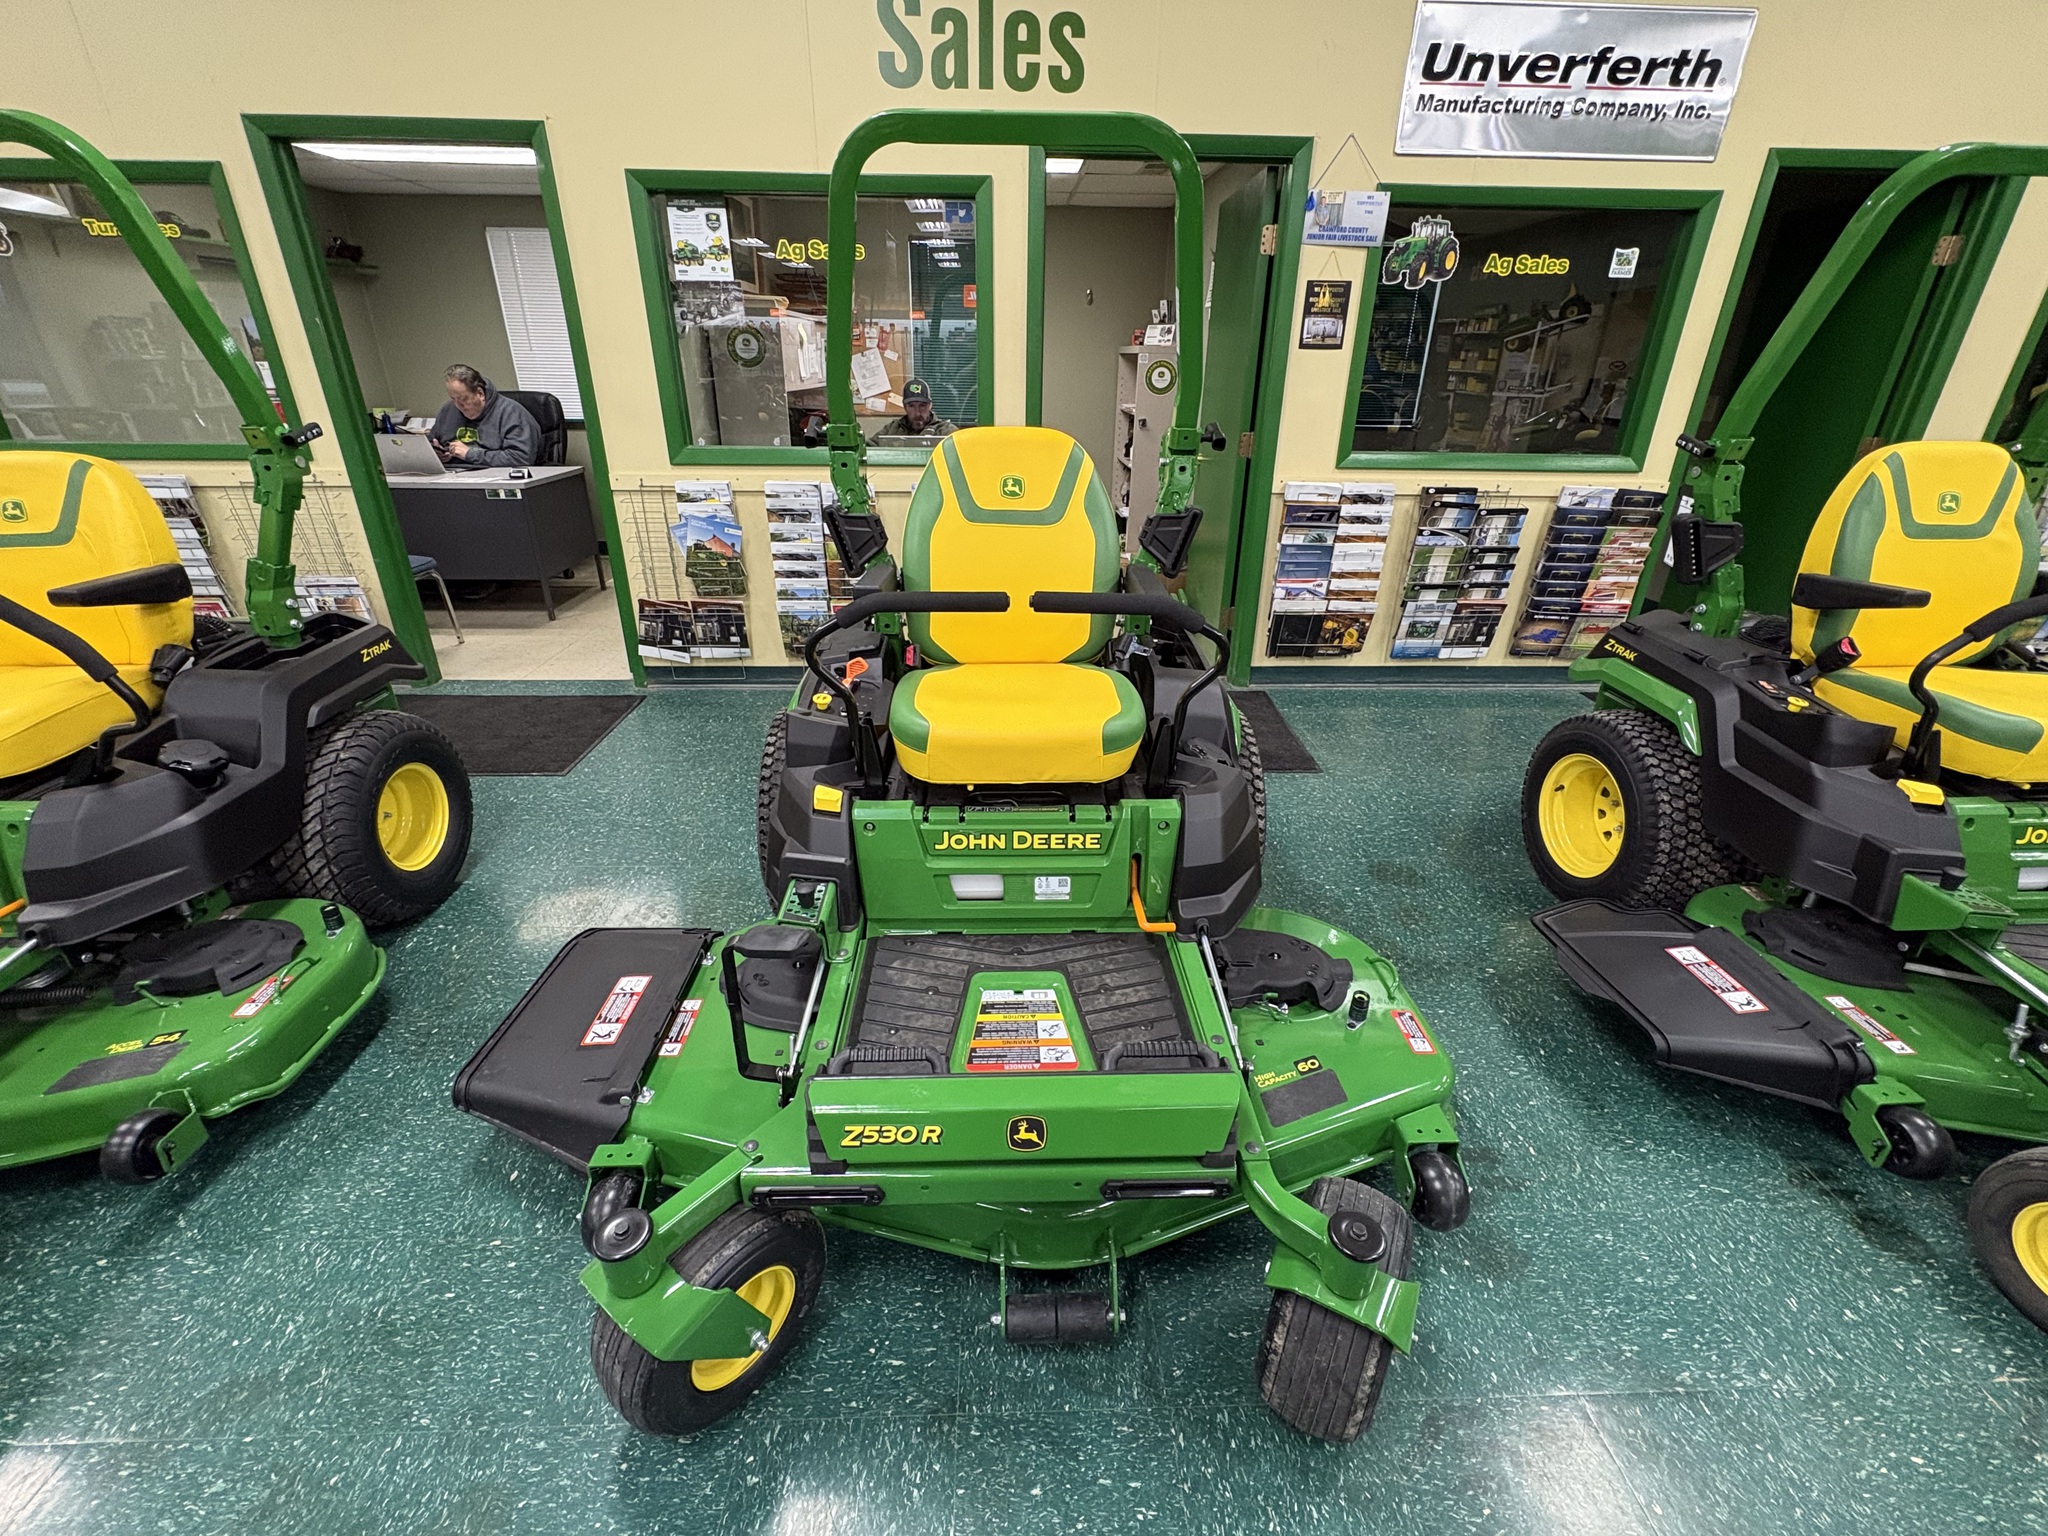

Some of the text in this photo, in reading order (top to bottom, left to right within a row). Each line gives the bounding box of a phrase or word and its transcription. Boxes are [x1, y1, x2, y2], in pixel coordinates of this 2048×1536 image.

[876, 0, 1086, 94] Sales
[1420, 42, 1724, 88] Unverferth
[1415, 93, 1712, 122] Manufacturing Company, Inc.
[82, 218, 123, 236] Tur
[1347, 226, 1369, 234] COUNTY
[1325, 233, 1337, 241] FAIR
[1337, 234, 1365, 242] LIVESTOCK
[775, 239, 806, 263] Ag
[1482, 253, 1570, 276] Ag Sales
[934, 830, 1101, 850] JOHN DEERE
[2015, 826, 2048, 845] JO
[149, 1032, 182, 1046] 54
[1297, 1059, 1320, 1072] 60
[1253, 1071, 1276, 1083] HIGH
[1257, 1070, 1297, 1088] CAPACITY
[840, 1125, 943, 1147] Z530 R
